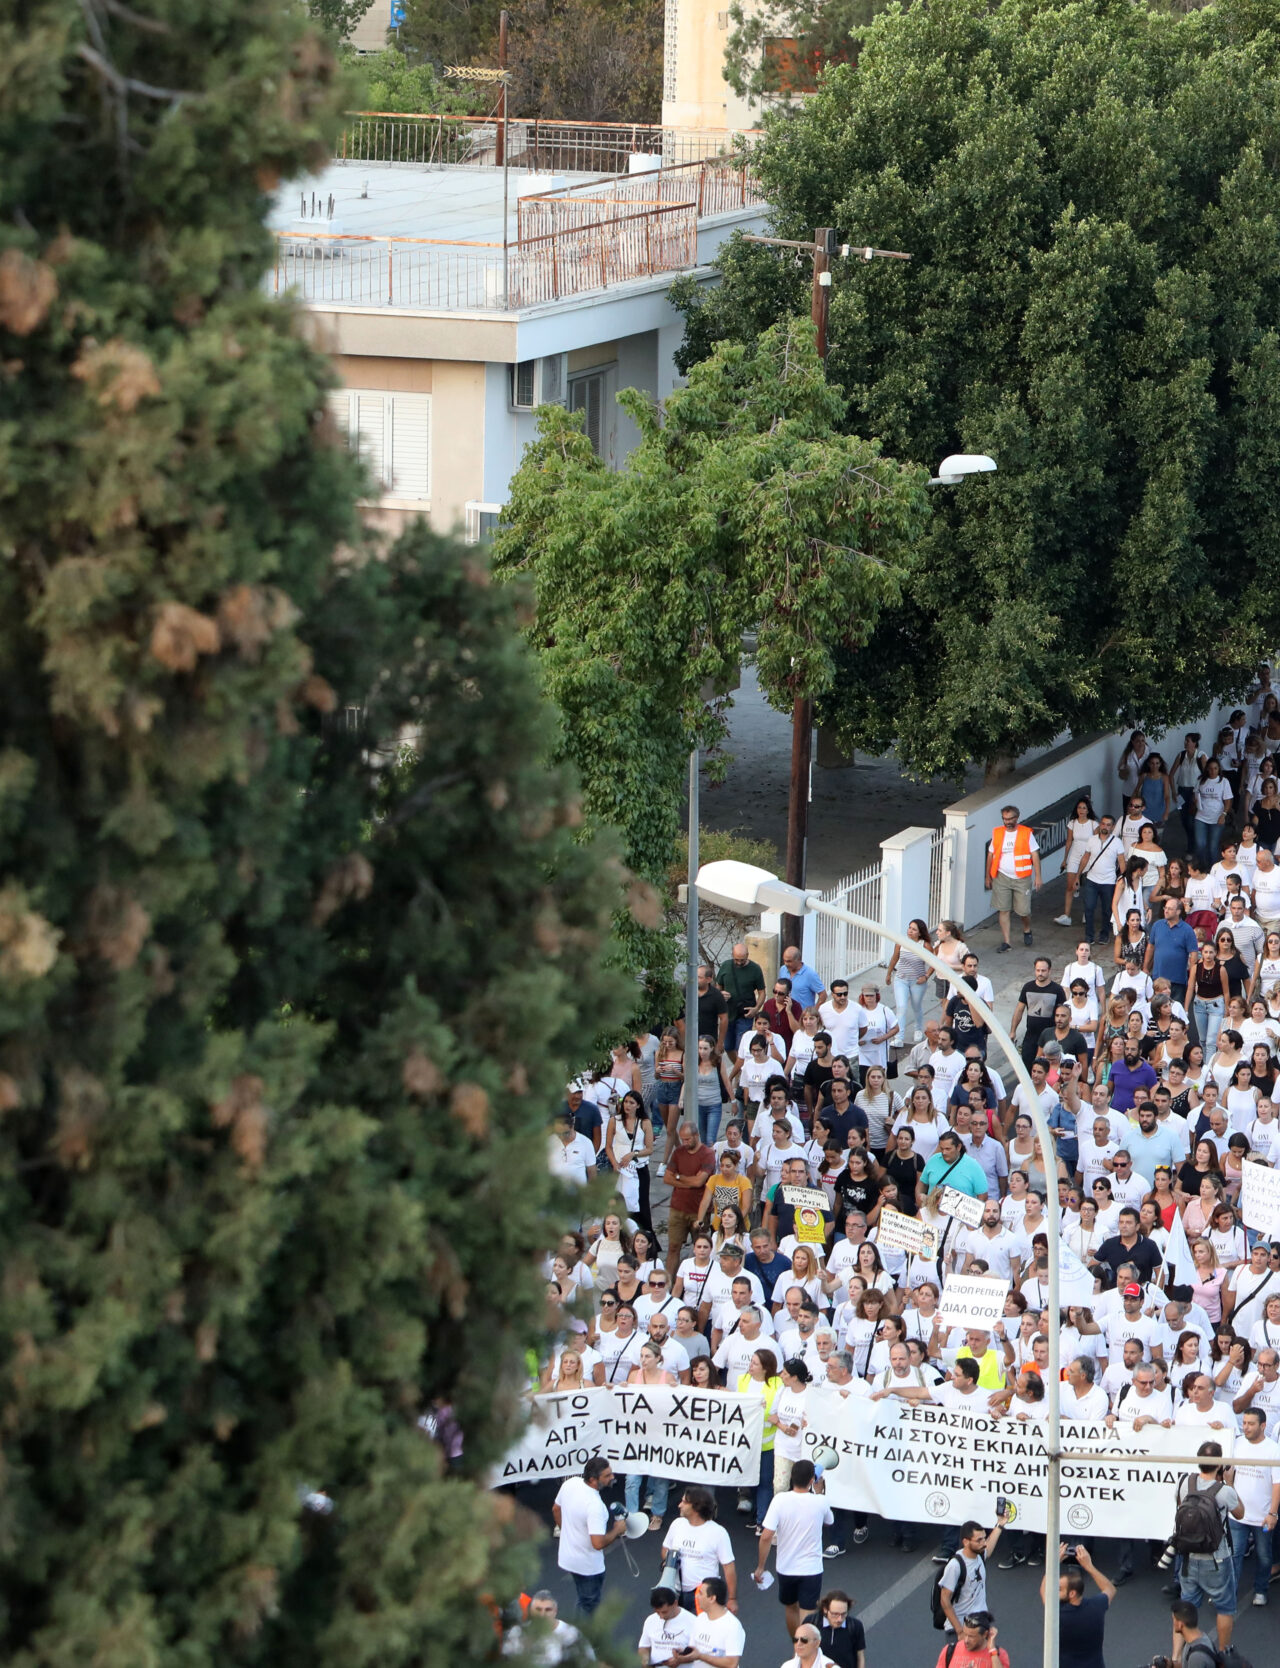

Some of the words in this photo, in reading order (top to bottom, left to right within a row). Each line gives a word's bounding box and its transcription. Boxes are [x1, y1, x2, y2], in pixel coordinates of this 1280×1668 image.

[614, 1392, 653, 1415] ΤΑ
[668, 1393, 745, 1428] ΧΕΡΙΑ
[899, 1408, 1001, 1433] ΣΕΒΑΣΜΟΣ
[1006, 1422, 1043, 1438] ΣΤΑ
[598, 1419, 648, 1436] ΤΗΝ
[662, 1422, 750, 1450] ΠΑΙΔΕΙΑ
[874, 1425, 903, 1441] ΚΑΙ
[909, 1428, 968, 1450] ΣΤΟΥΣ
[503, 1444, 602, 1477] ΔΙΑΛΟΓΟΣ
[623, 1442, 744, 1474] ΔΗΜΟΚΡΑΤΙΑ
[804, 1432, 837, 1449] ΟΧΙ
[842, 1440, 878, 1458] ΣΤΗ
[884, 1448, 964, 1470] ΔΙΑΛΥΣΗ
[970, 1458, 1008, 1474] ΤΗΣ
[892, 1469, 974, 1491] ΟΕΛΜΕΚ
